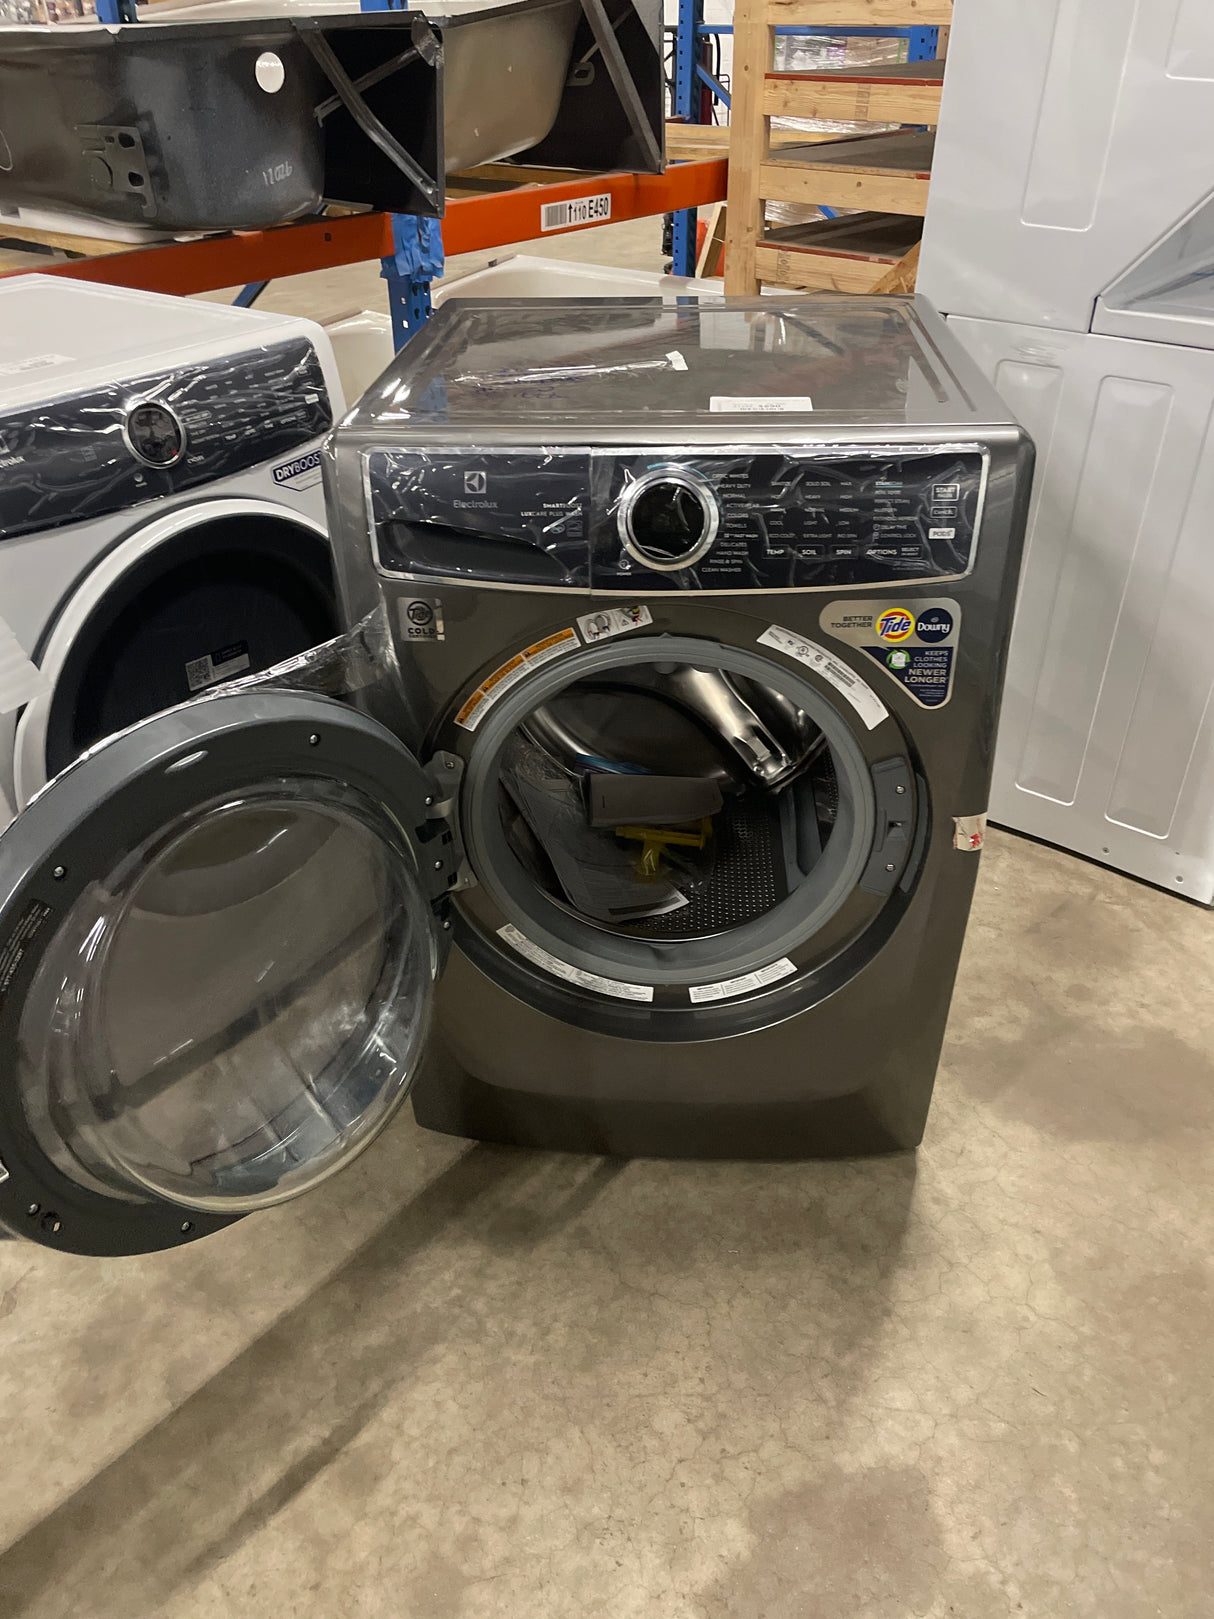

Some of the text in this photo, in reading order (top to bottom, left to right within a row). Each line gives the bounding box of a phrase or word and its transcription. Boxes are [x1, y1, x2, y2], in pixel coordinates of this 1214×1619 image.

[573, 197, 609, 221] 110 E450
[453, 500, 499, 509] Electrolux
[408, 627, 435, 635] COLD
[879, 616, 912, 637] Tide
[917, 622, 950, 633] Downy
[908, 668, 947, 676] NEWER
[904, 675, 946, 684] LONGER
